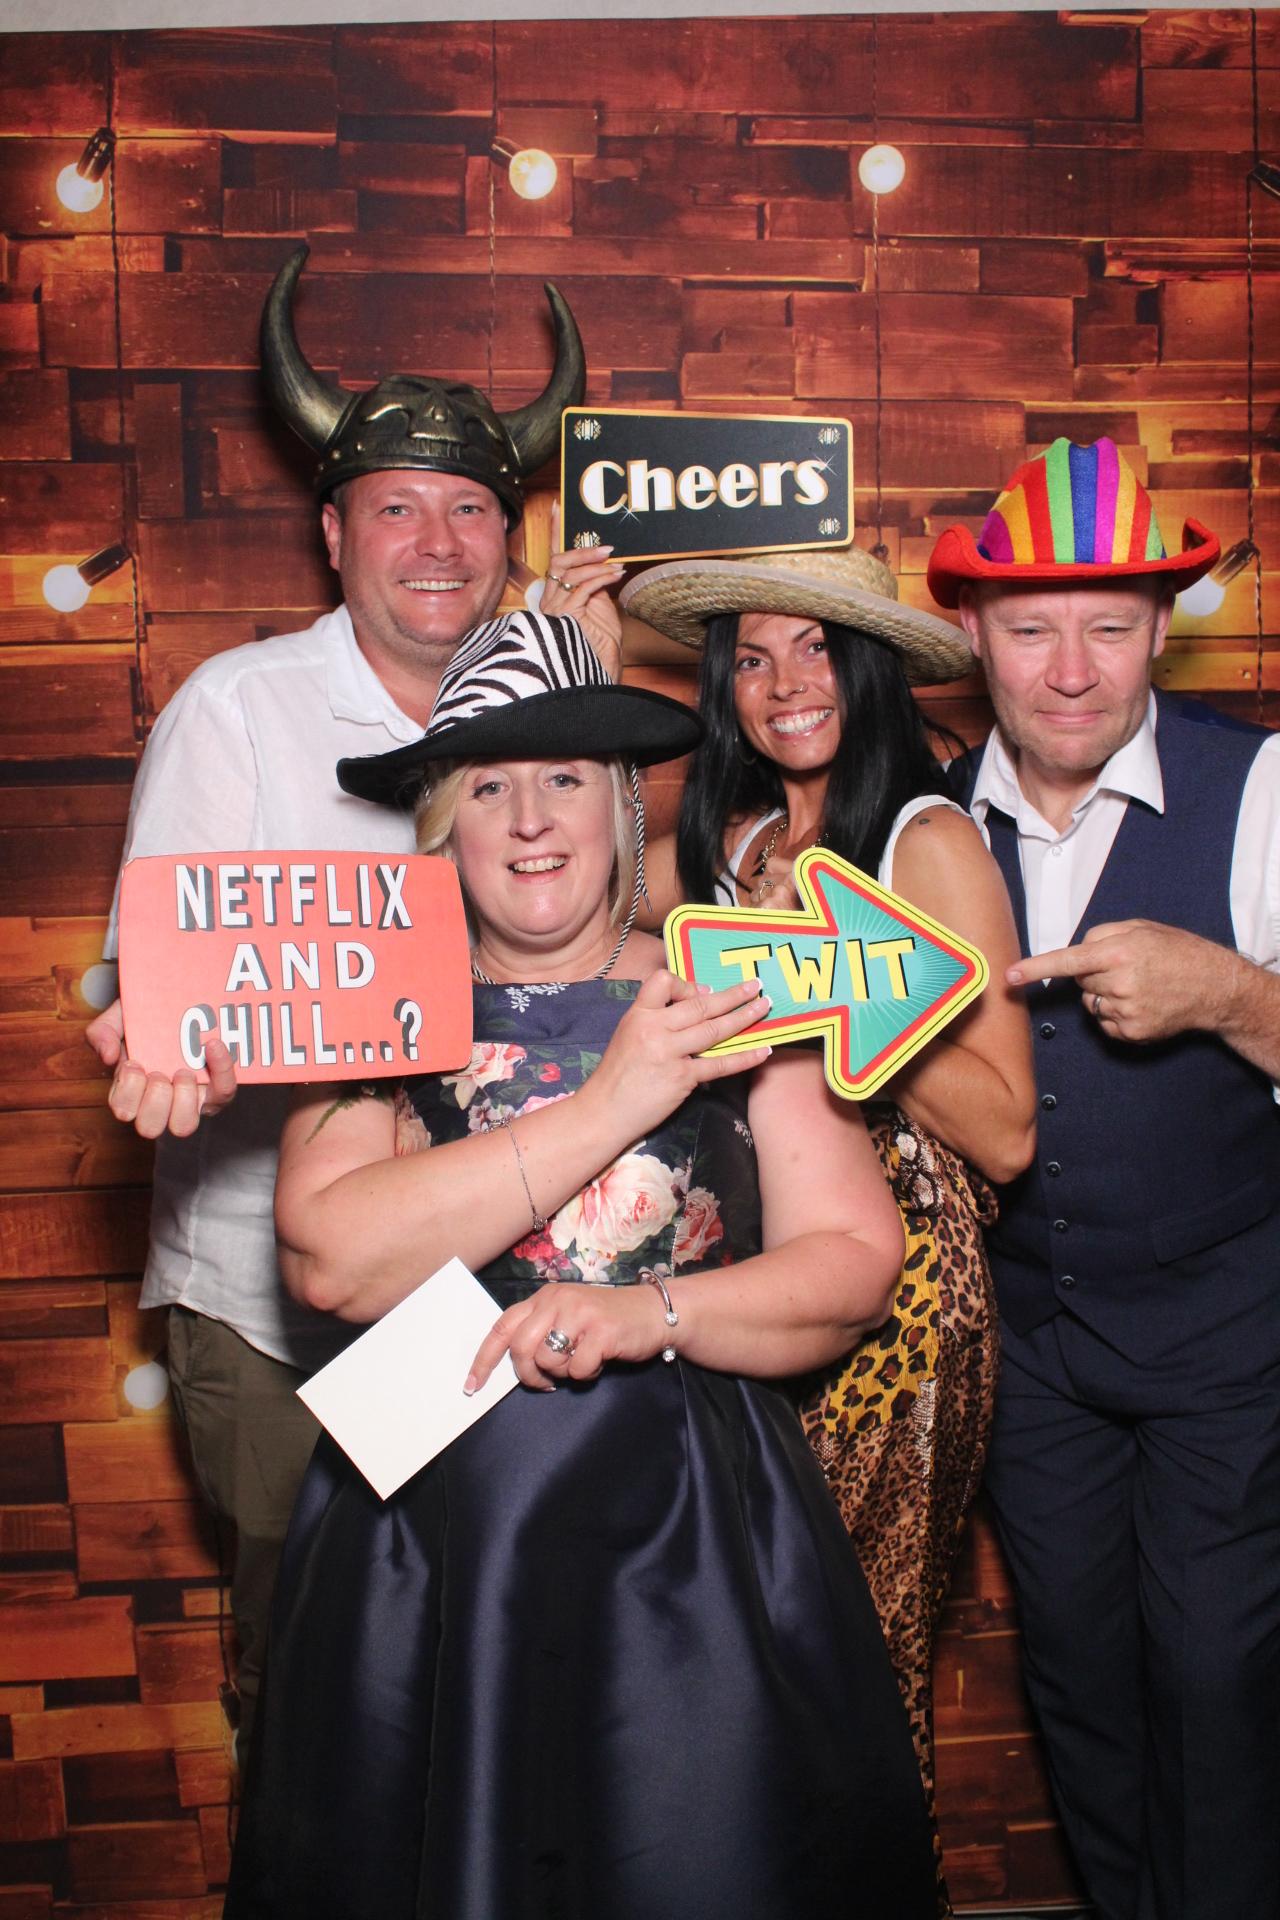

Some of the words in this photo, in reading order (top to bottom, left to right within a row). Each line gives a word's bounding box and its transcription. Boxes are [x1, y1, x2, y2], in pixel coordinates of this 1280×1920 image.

[580, 459, 829, 515] Cheers
[175, 864, 413, 931] NETFLIX
[225, 941, 377, 992] AND
[720, 937, 916, 1003] TWIT
[179, 997, 423, 1070] CHILL...?
